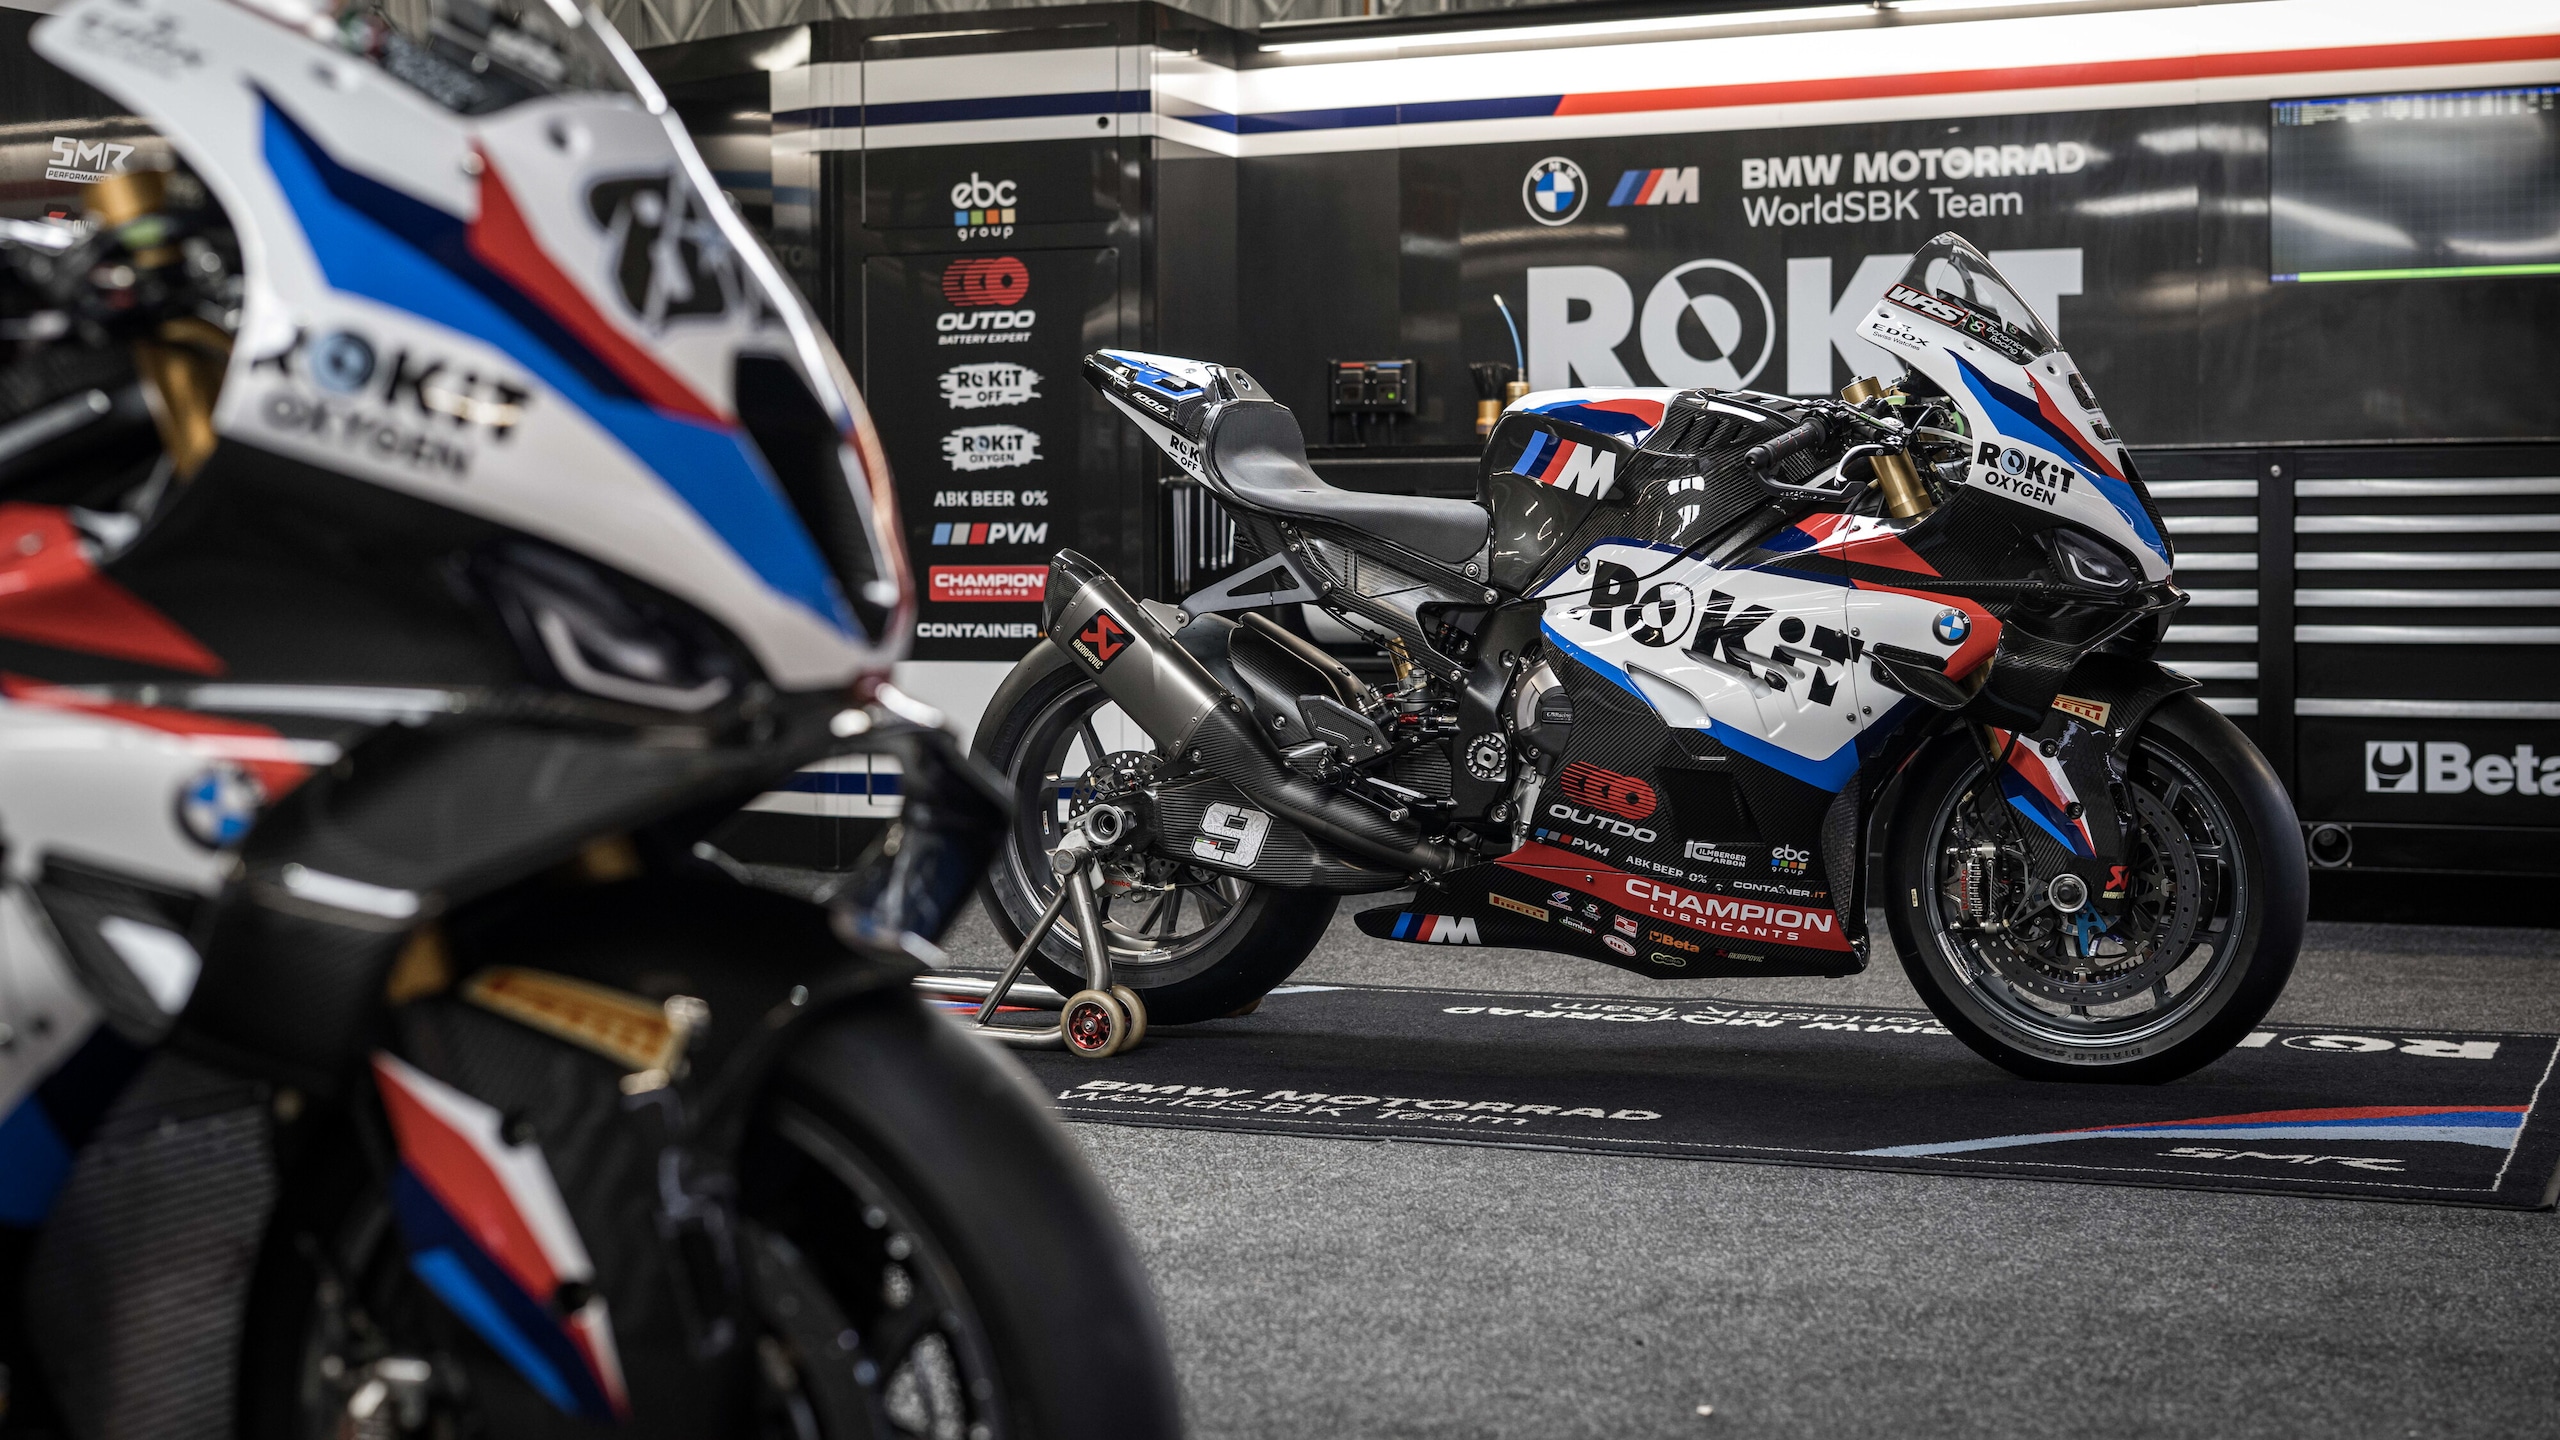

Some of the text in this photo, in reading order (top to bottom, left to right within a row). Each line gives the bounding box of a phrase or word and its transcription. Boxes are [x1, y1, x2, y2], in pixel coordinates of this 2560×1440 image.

[49, 136, 135, 172] SMR
[1741, 142, 2086, 190] BMW MOTORRAD
[48, 170, 110, 183] PERFORMANC
[951, 172, 1017, 209] ebc
[1742, 186, 2023, 227] WorldSBK Team
[957, 226, 1014, 241] group
[1888, 286, 1965, 322] WRS
[936, 310, 1036, 331] OUTDO
[938, 332, 1032, 345] BATTERY EXPERT
[1872, 323, 1930, 347] EDOX
[1873, 331, 1920, 350] Swiss Watches
[1988, 335, 2019, 355] Racing
[958, 370, 1022, 388] ROKiT
[977, 391, 1002, 402] OFF
[1132, 391, 1169, 413] 1000
[962, 435, 1024, 453] ROKiT
[1170, 434, 1200, 463] ROK
[969, 453, 1015, 464] OXYGEN
[1180, 456, 1198, 471] OFF
[1977, 441, 2075, 494] ROKiT
[934, 490, 1048, 507] ABK BEER 0%
[1985, 472, 2056, 506] OXYGEN
[987, 523, 1048, 544] PVM
[935, 574, 1044, 588] CHAMPION
[949, 587, 1028, 596] LUBRICANTS
[1549, 804, 1657, 843] OUTDO
[1571, 837, 1610, 857] PVM
[1771, 844, 1810, 862] ebc
[1626, 856, 1708, 884] ABK BEER 0%
[1771, 866, 1803, 876] group
[1733, 881, 1827, 899] CONTANER.IT
[1626, 878, 1833, 932] CHAMPION
[1650, 904, 1799, 941] LUBRICANTS
[1662, 934, 1699, 953] Beta
[1076, 1080, 1662, 1122] BMW MOTORRAD
[1376, 1107, 1529, 1126] Team
